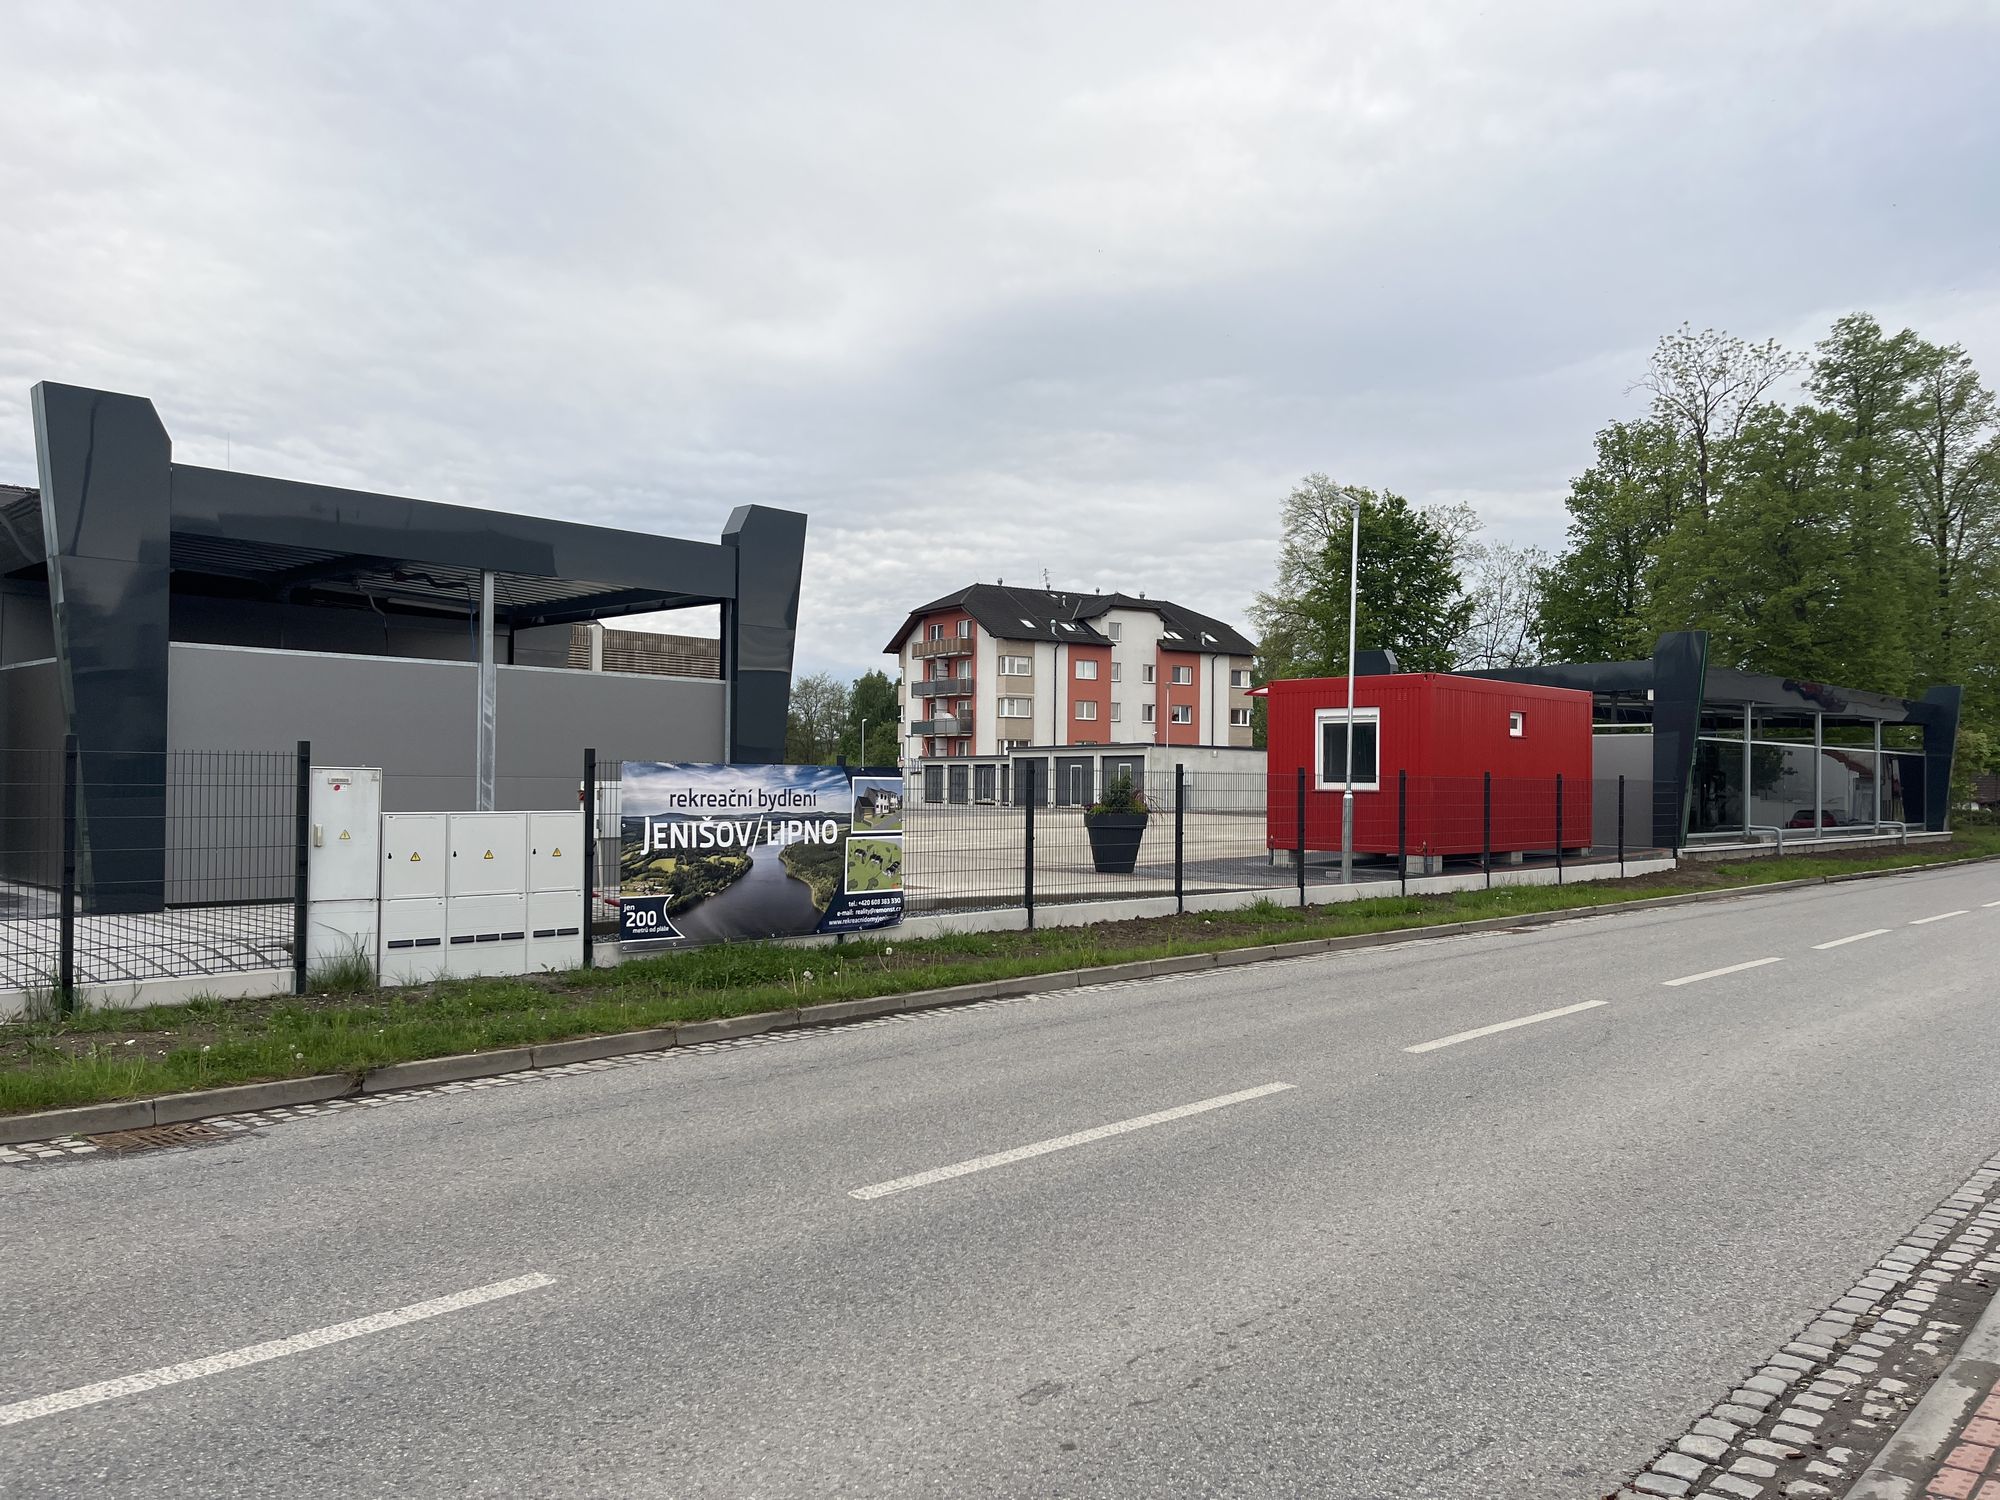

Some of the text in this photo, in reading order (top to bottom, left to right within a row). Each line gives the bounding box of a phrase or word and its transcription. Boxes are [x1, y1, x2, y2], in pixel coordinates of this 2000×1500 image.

[669, 788, 817, 811] rekreační bydlení
[623, 903, 635, 913] jen
[626, 910, 656, 927] 200
